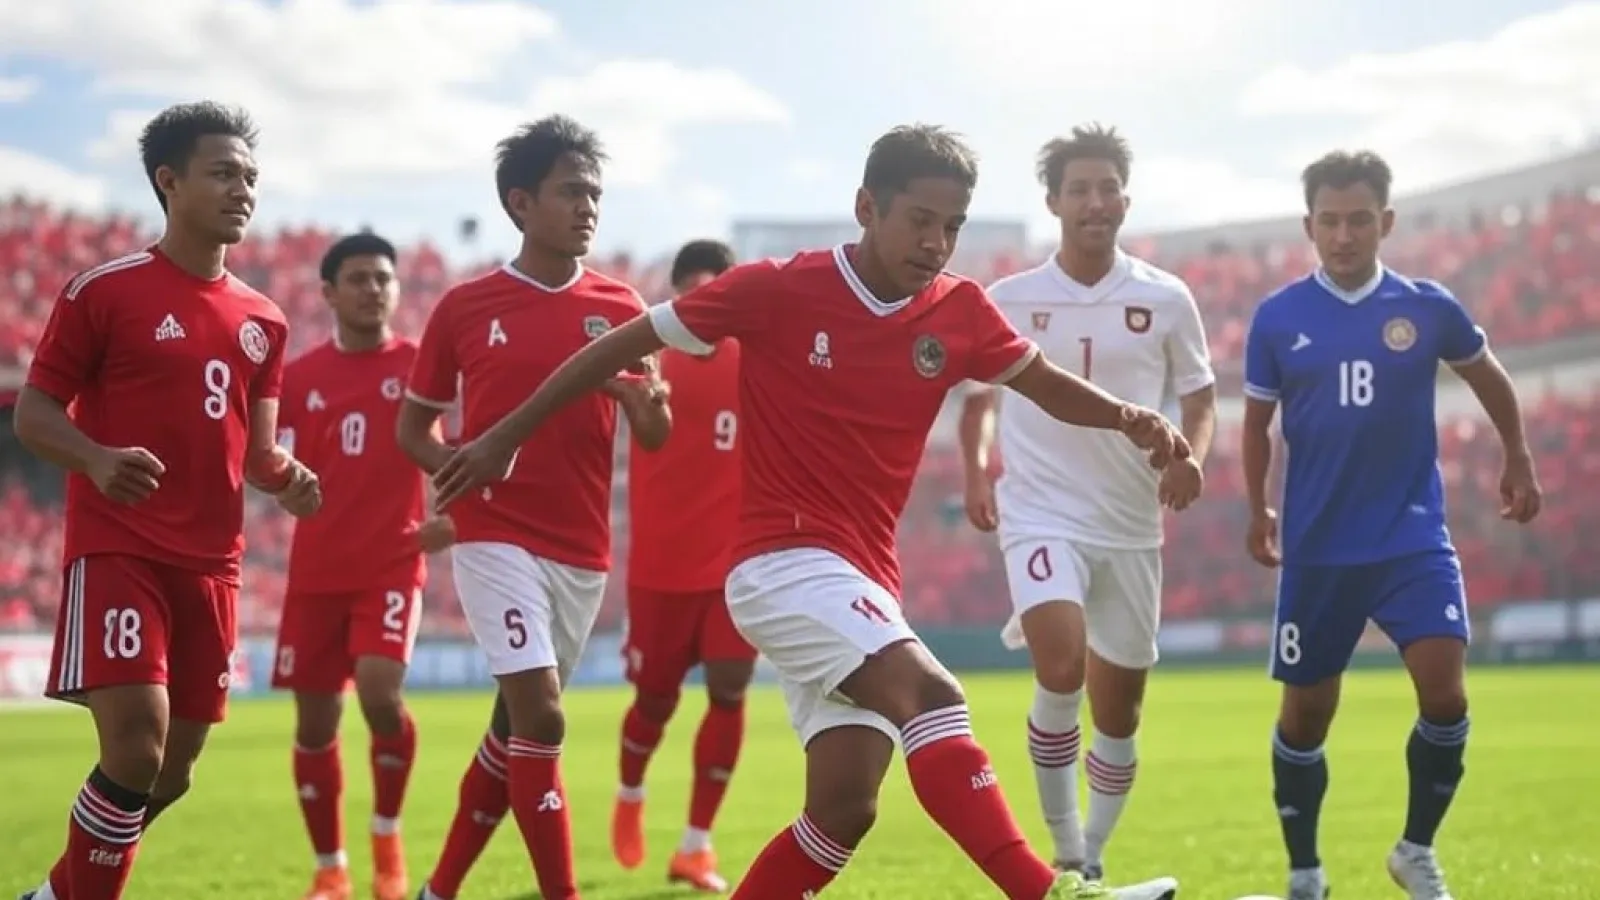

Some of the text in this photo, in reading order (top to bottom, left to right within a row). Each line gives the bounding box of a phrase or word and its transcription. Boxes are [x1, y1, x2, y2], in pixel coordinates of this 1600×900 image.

[1339, 359, 1374, 407] 18
[714, 409, 737, 451] 9
[383, 589, 405, 630] 2
[1280, 622, 1302, 665] 8
